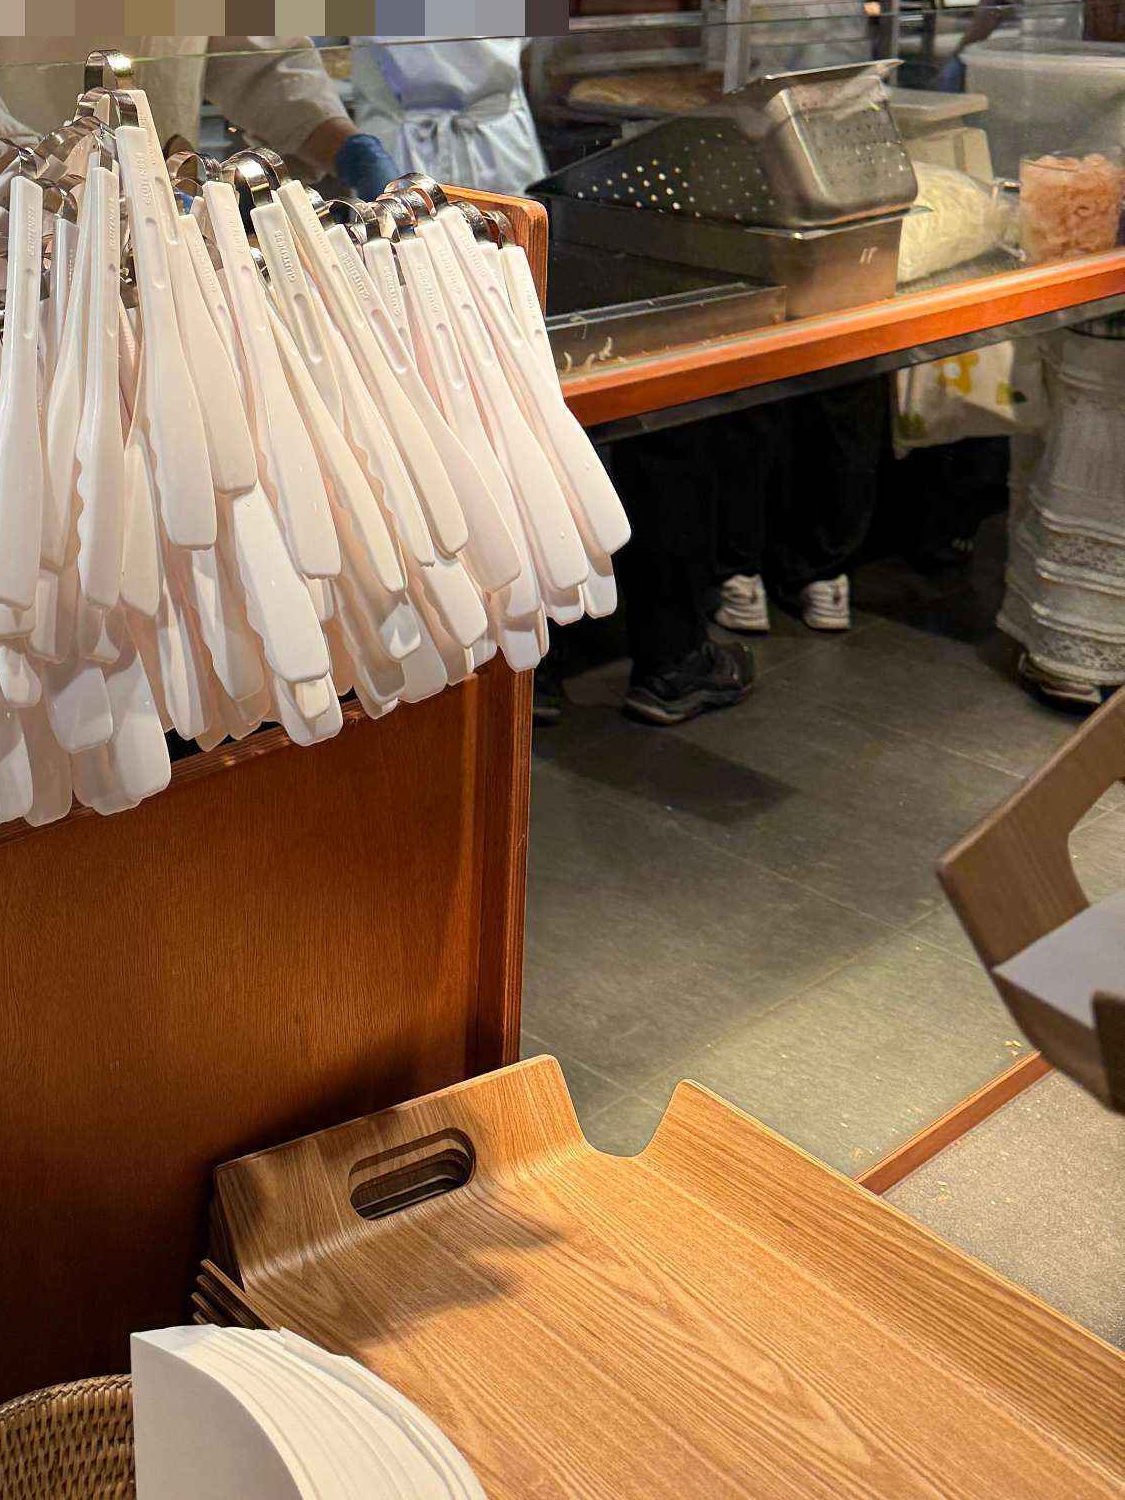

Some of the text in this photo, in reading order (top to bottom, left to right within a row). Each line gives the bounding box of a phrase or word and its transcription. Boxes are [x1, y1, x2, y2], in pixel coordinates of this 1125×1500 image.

[27, 205, 36, 256] GLUTEN898
[274, 230, 297, 283] GLUTEN898
[341, 251, 370, 301] GLUTEN898
[383, 265, 399, 316] GLUTEN898
[417, 263, 439, 313] GLUTEN898
